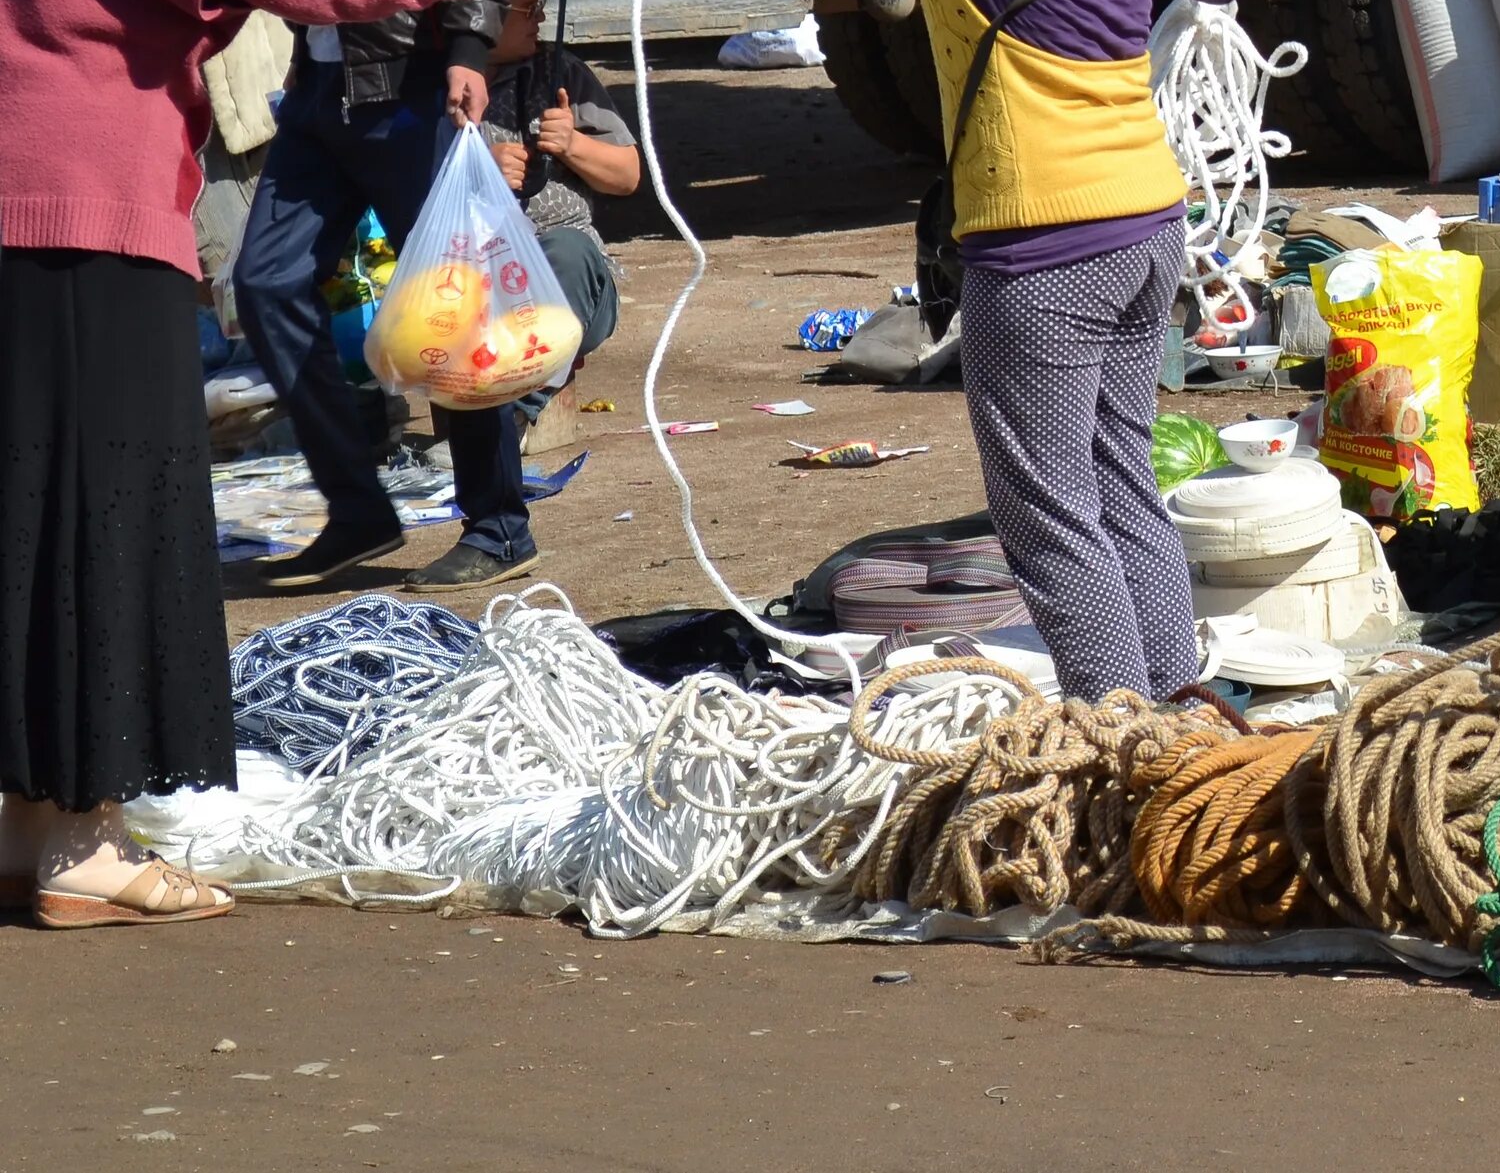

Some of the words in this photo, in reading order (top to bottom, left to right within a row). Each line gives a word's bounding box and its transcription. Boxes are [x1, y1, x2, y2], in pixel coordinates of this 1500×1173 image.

[1405, 302, 1443, 313] вкус
[1326, 345, 1363, 371] aggi
[1325, 436, 1338, 449] НА
[1339, 439, 1394, 461] КОСТОЧКЕ
